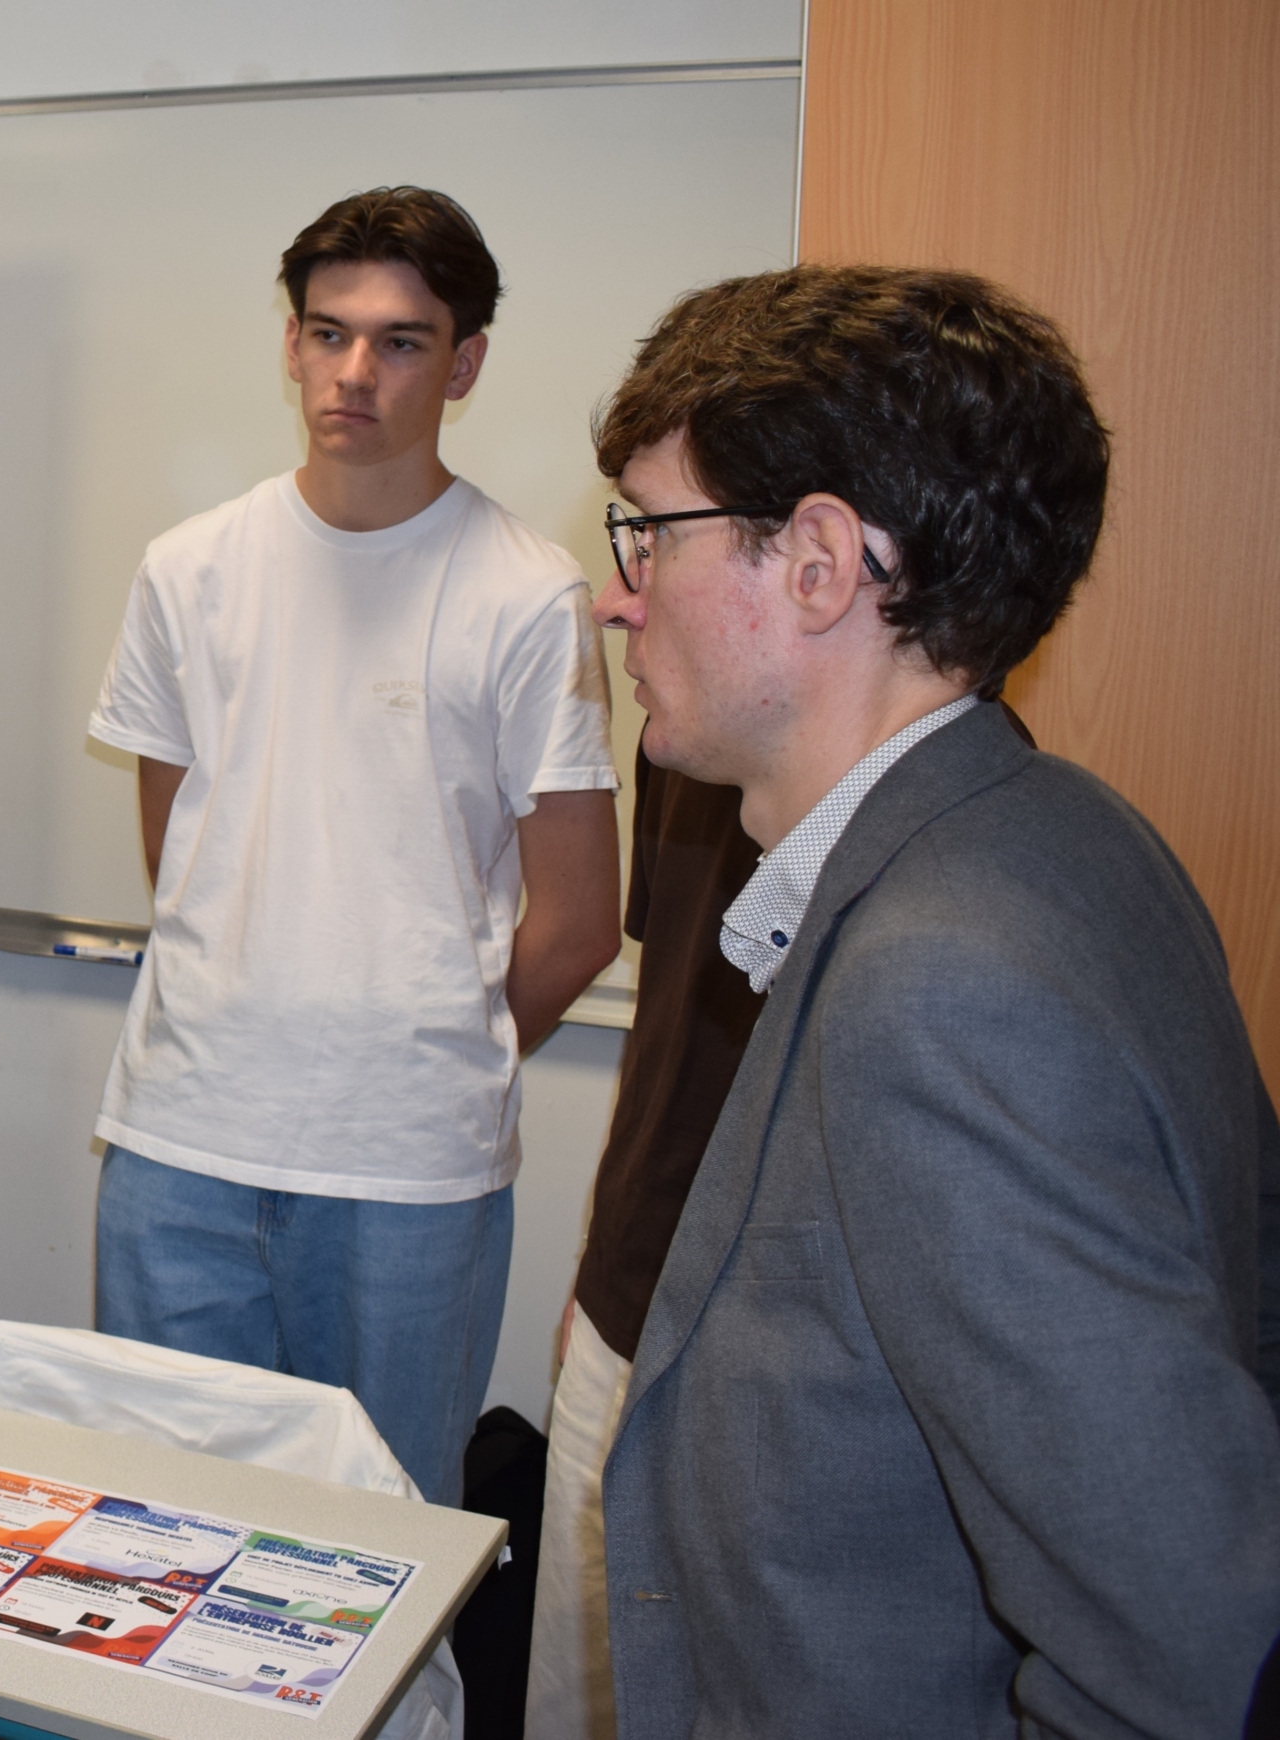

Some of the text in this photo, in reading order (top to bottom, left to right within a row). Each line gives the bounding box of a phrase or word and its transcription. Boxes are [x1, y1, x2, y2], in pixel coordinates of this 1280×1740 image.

[125, 1549, 182, 1568] Hexatel
[252, 1542, 341, 1568] PROFESSIONNEL
[257, 1535, 400, 1574] PRÉSENTATION PARCOURS
[119, 1580, 183, 1601] PARCOURS
[293, 1588, 348, 1605] axione
[86, 1615, 106, 1628] N
[201, 1600, 306, 1632] PRÉSENTATION DE
[275, 1686, 323, 1706] R&T
